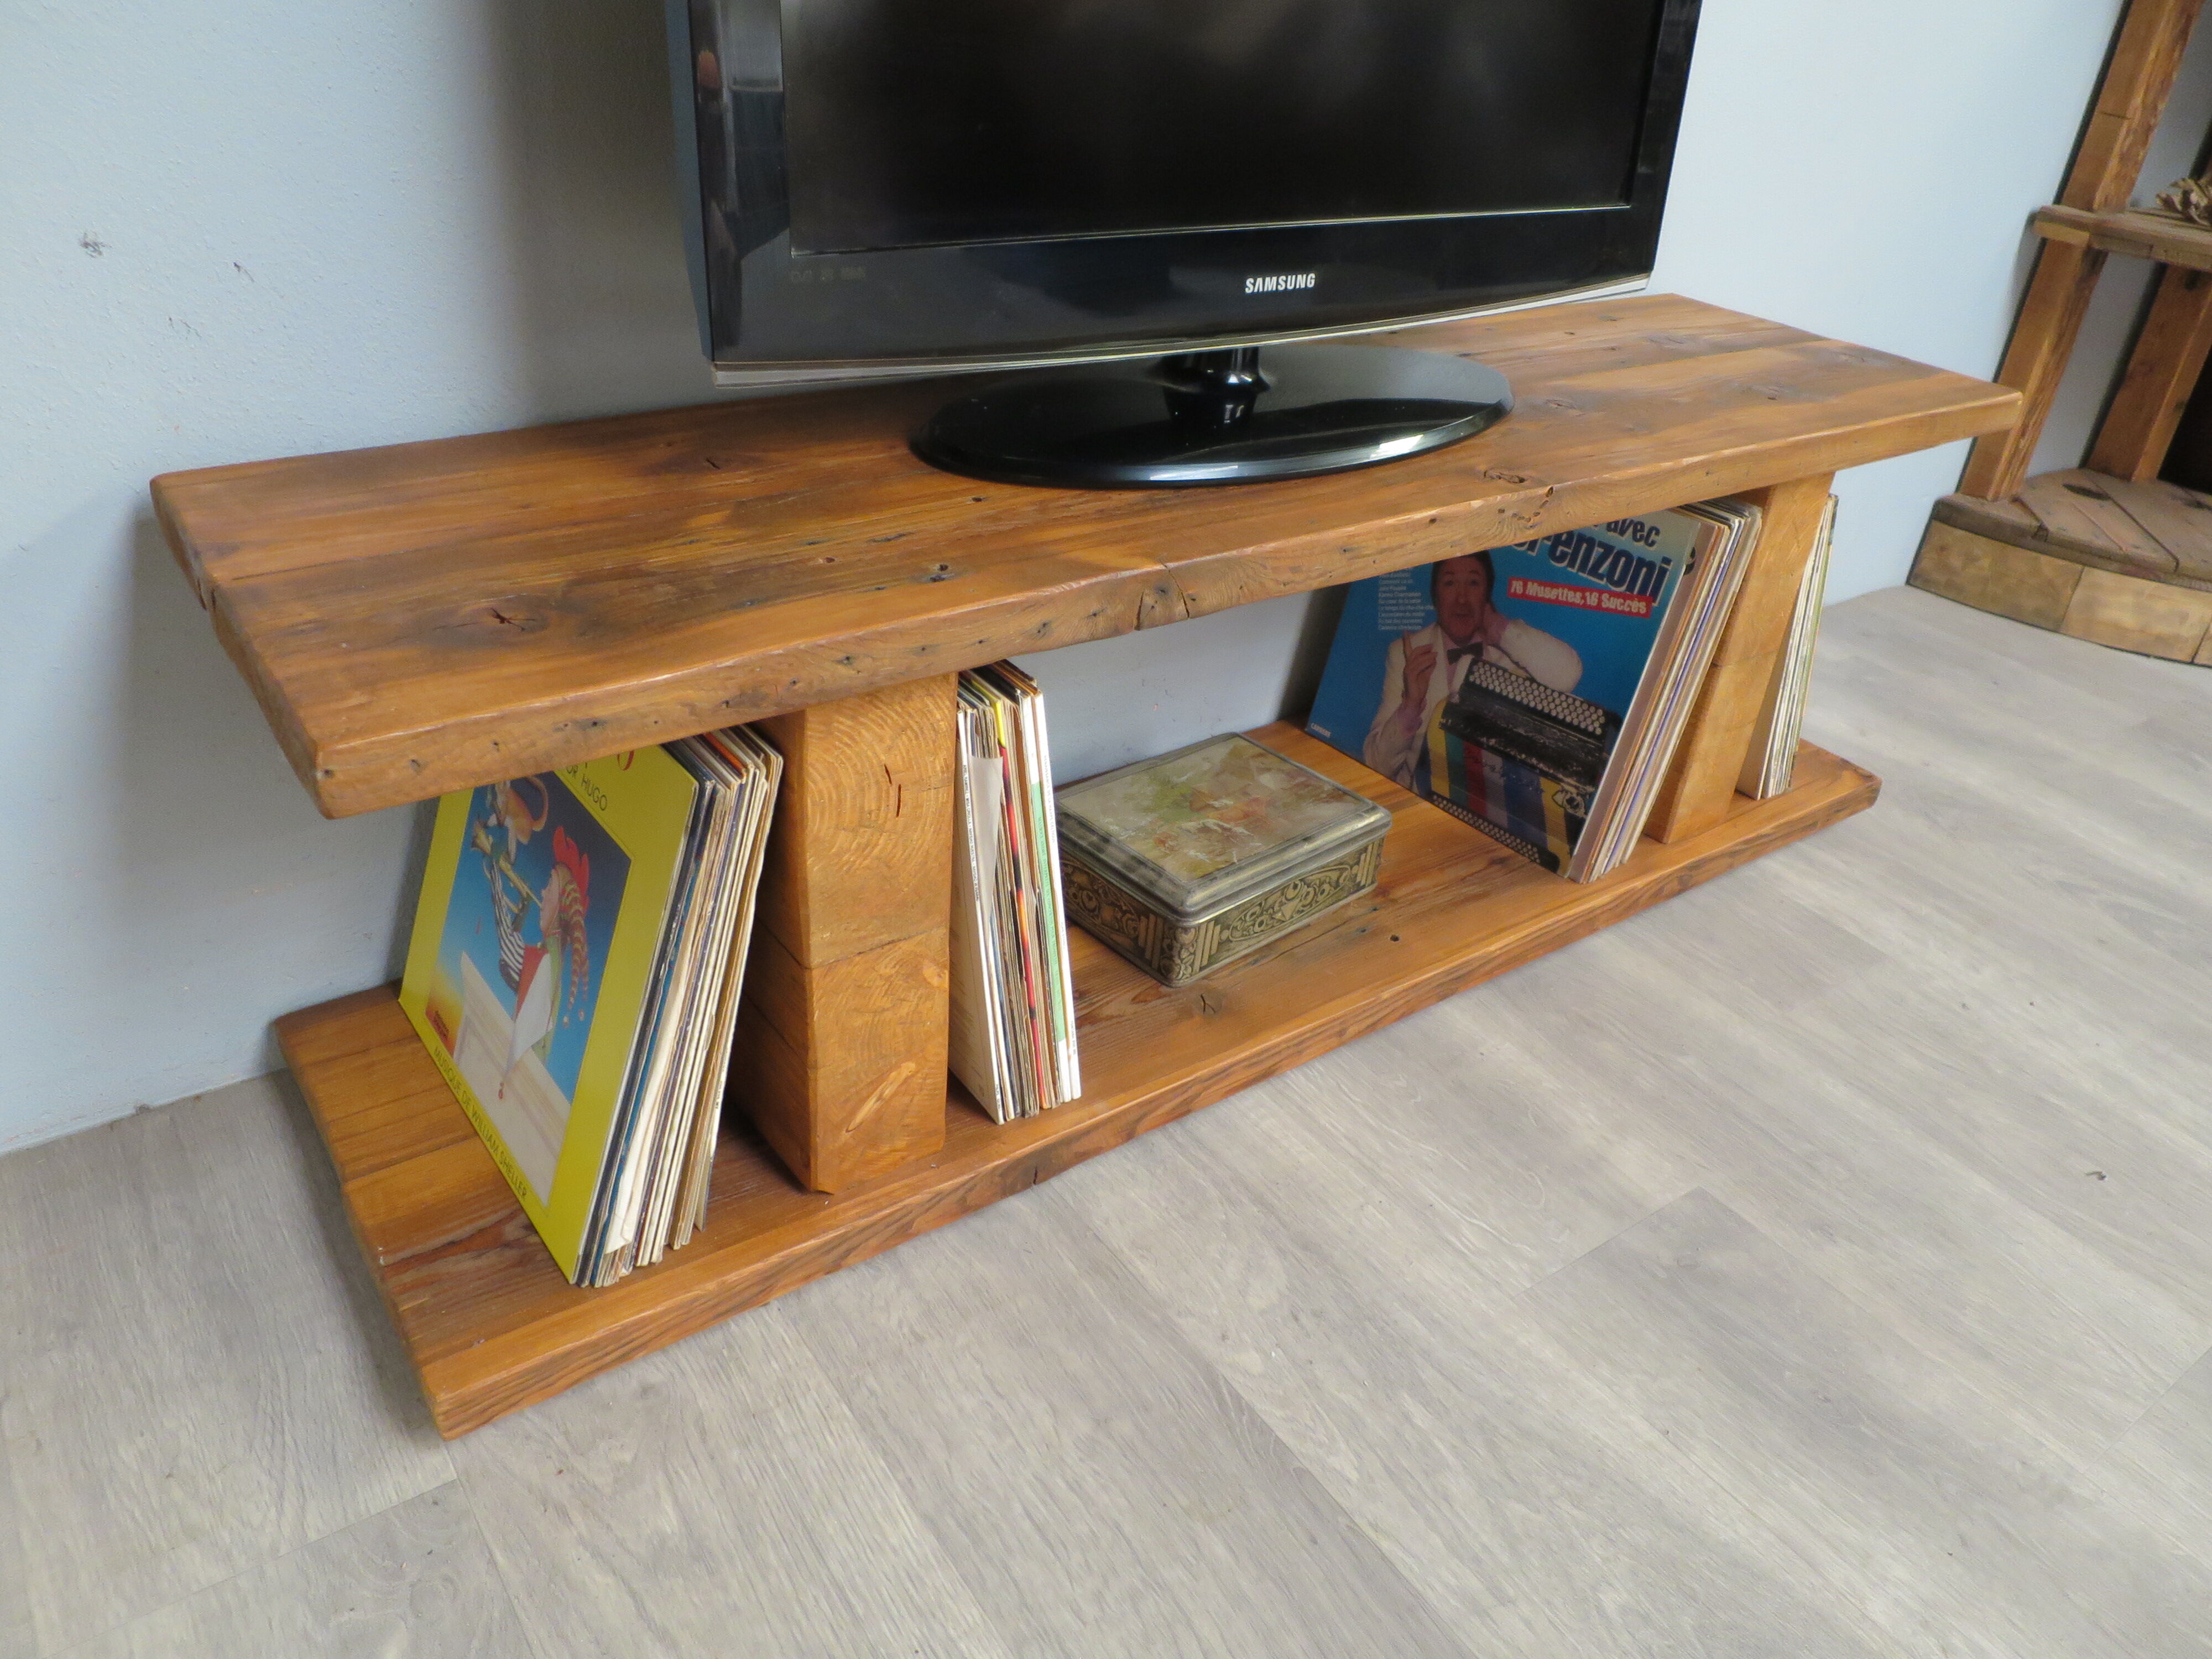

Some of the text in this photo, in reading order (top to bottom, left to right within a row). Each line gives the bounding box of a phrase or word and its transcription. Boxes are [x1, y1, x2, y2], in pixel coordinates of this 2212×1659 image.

[1245, 273, 1316, 294] SAMSUNG
[1606, 518, 1661, 549] avec
[1601, 593, 1647, 614] Succès
[581, 773, 607, 811] HUGO
[462, 1090, 471, 1108] DE
[471, 1105, 498, 1154] WILLIAM
[499, 1150, 527, 1198] SHELLER
